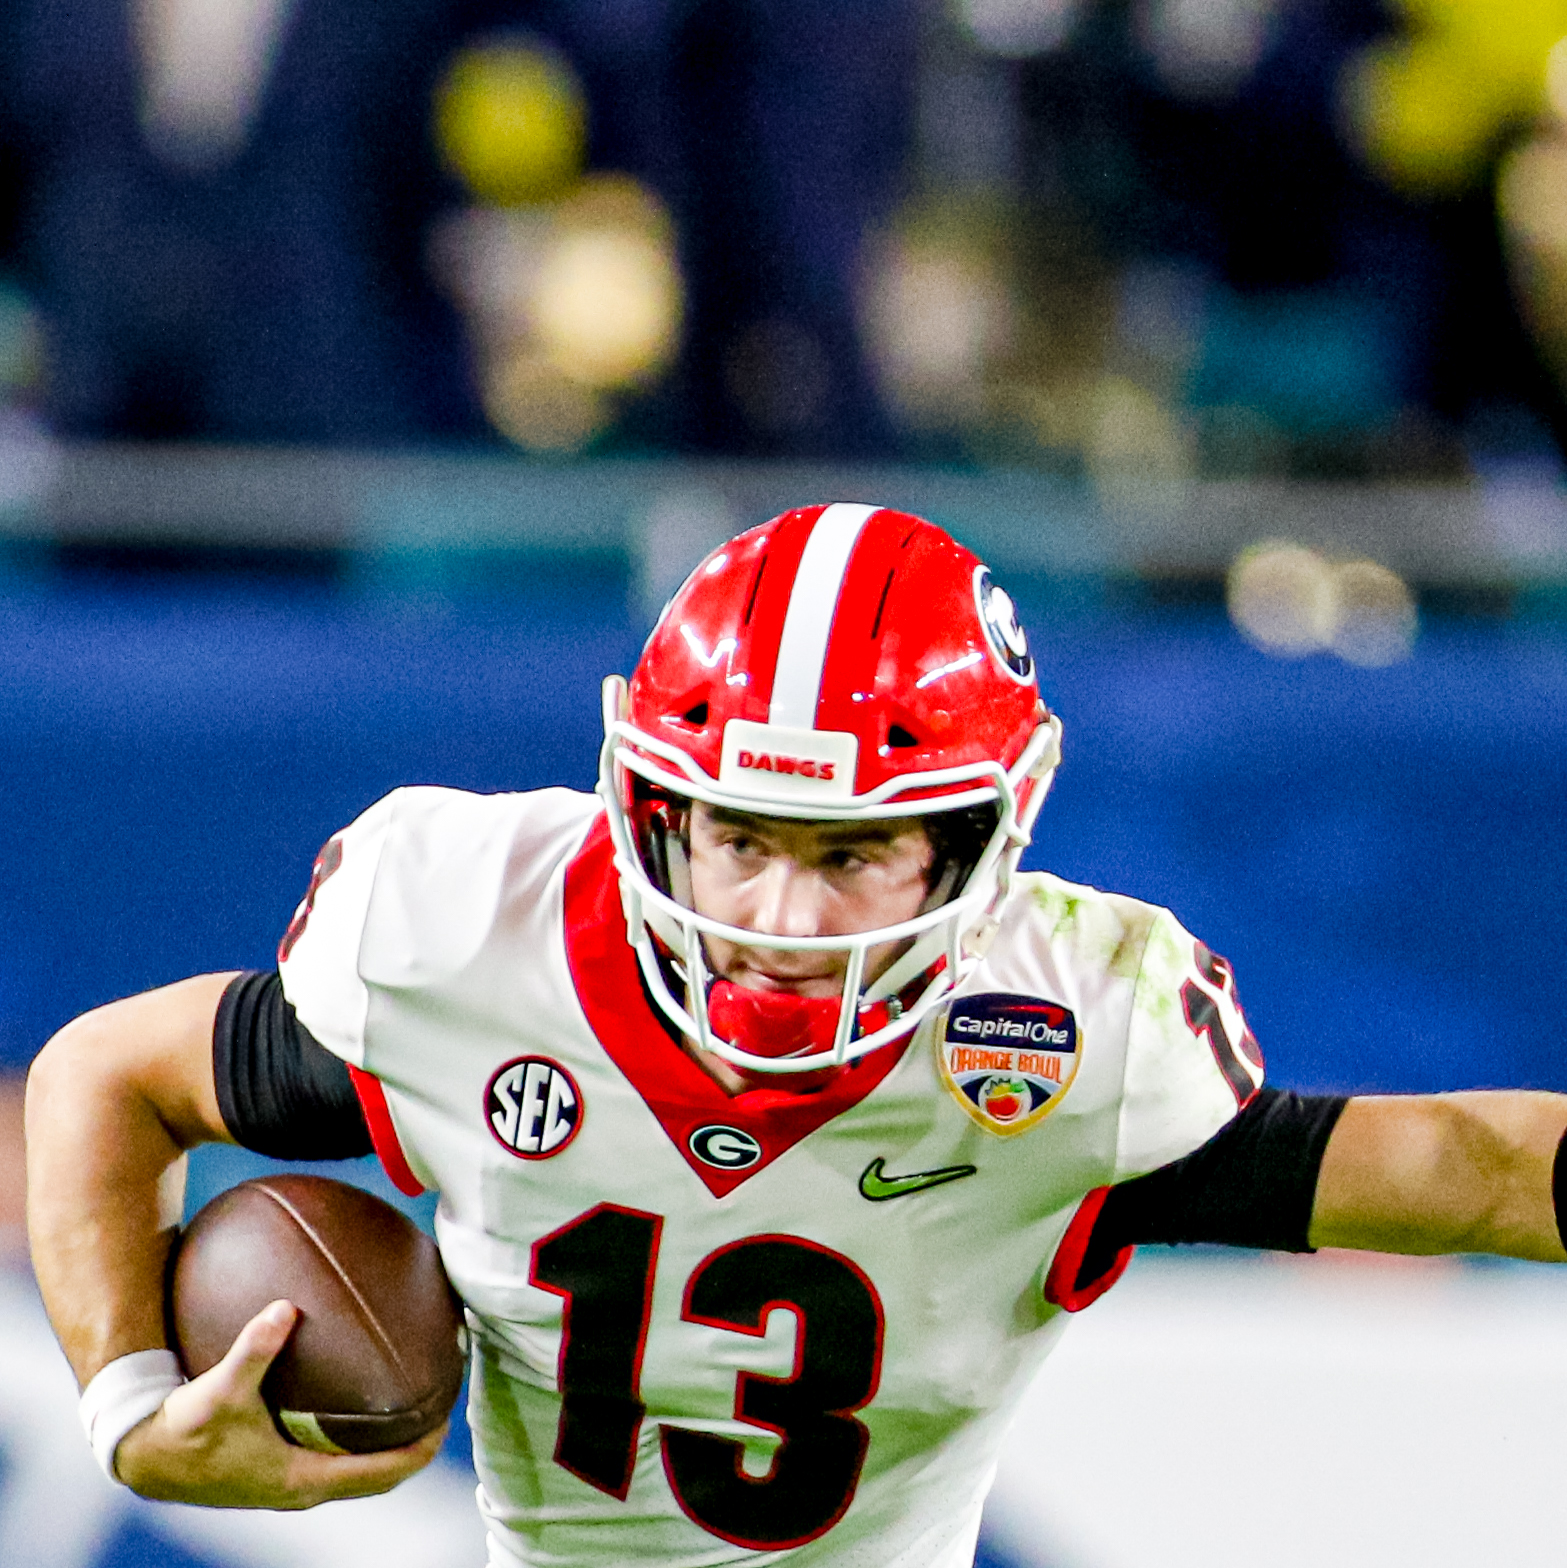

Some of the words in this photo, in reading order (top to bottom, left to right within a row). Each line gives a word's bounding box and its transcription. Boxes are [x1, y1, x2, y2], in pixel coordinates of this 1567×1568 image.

[737, 749, 836, 781] DAWGS
[950, 1047, 1013, 1075] ORANGE
[1018, 1051, 1063, 1084] BOWL
[491, 1062, 576, 1153] SEC
[703, 1130, 762, 1165] G
[529, 1199, 887, 1553] 13
